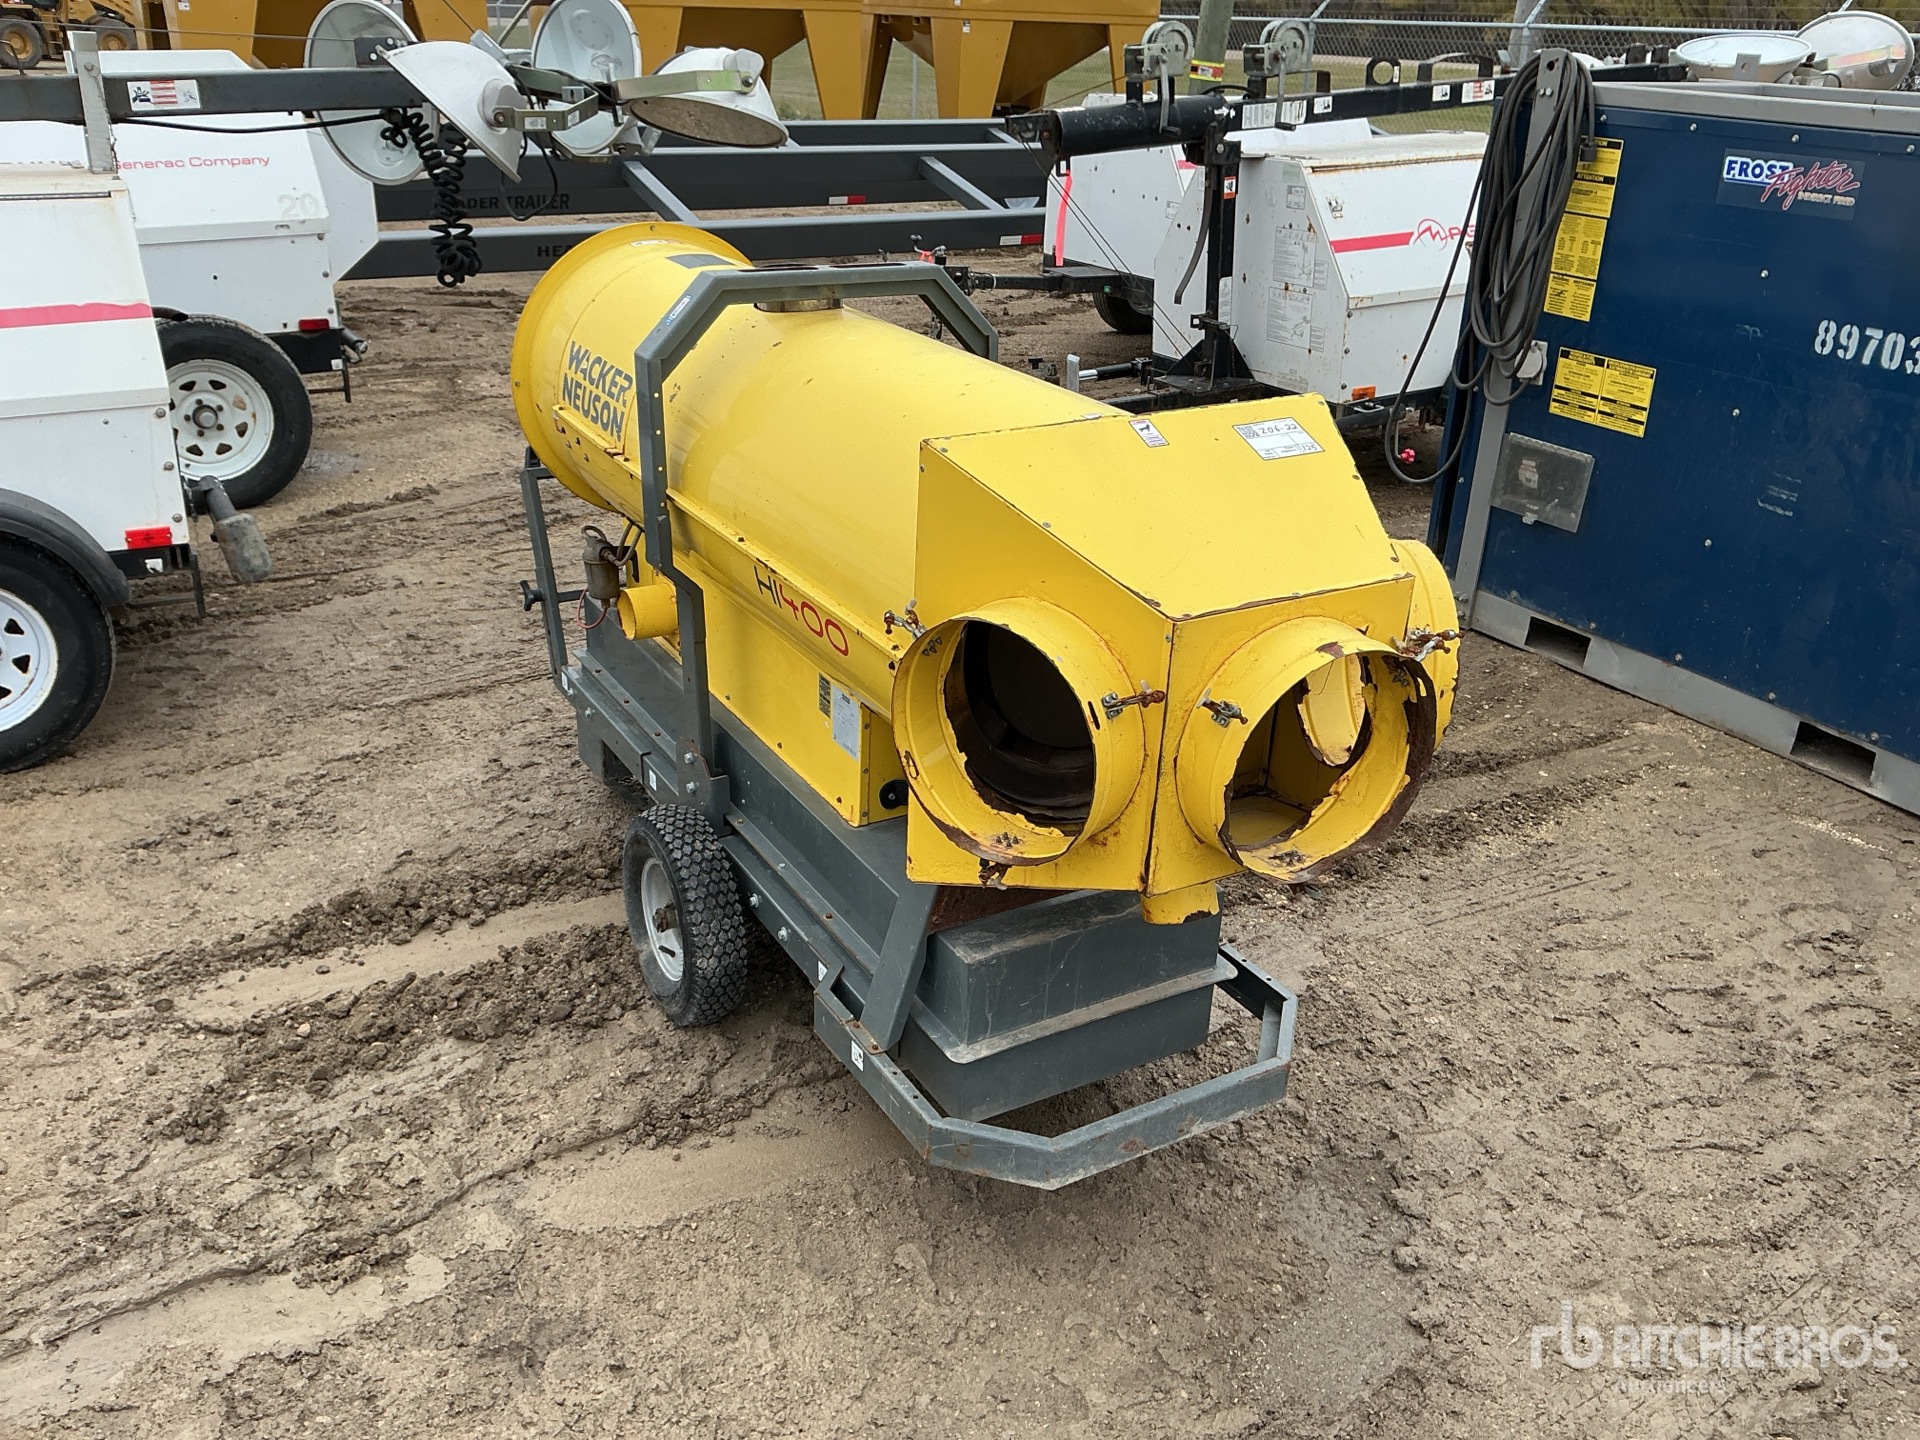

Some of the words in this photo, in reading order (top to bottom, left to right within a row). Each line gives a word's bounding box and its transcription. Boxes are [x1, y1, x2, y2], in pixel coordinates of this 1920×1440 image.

[189, 156, 271, 168] Company
[1724, 157, 1793, 183] FROST
[1761, 161, 1861, 210] Fighter
[506, 193, 570, 210] TRAILER
[568, 340, 634, 408] WACKER
[1815, 320, 1920, 375] 89703
[562, 372, 625, 443] NEUSON
[753, 565, 849, 657] HI400
